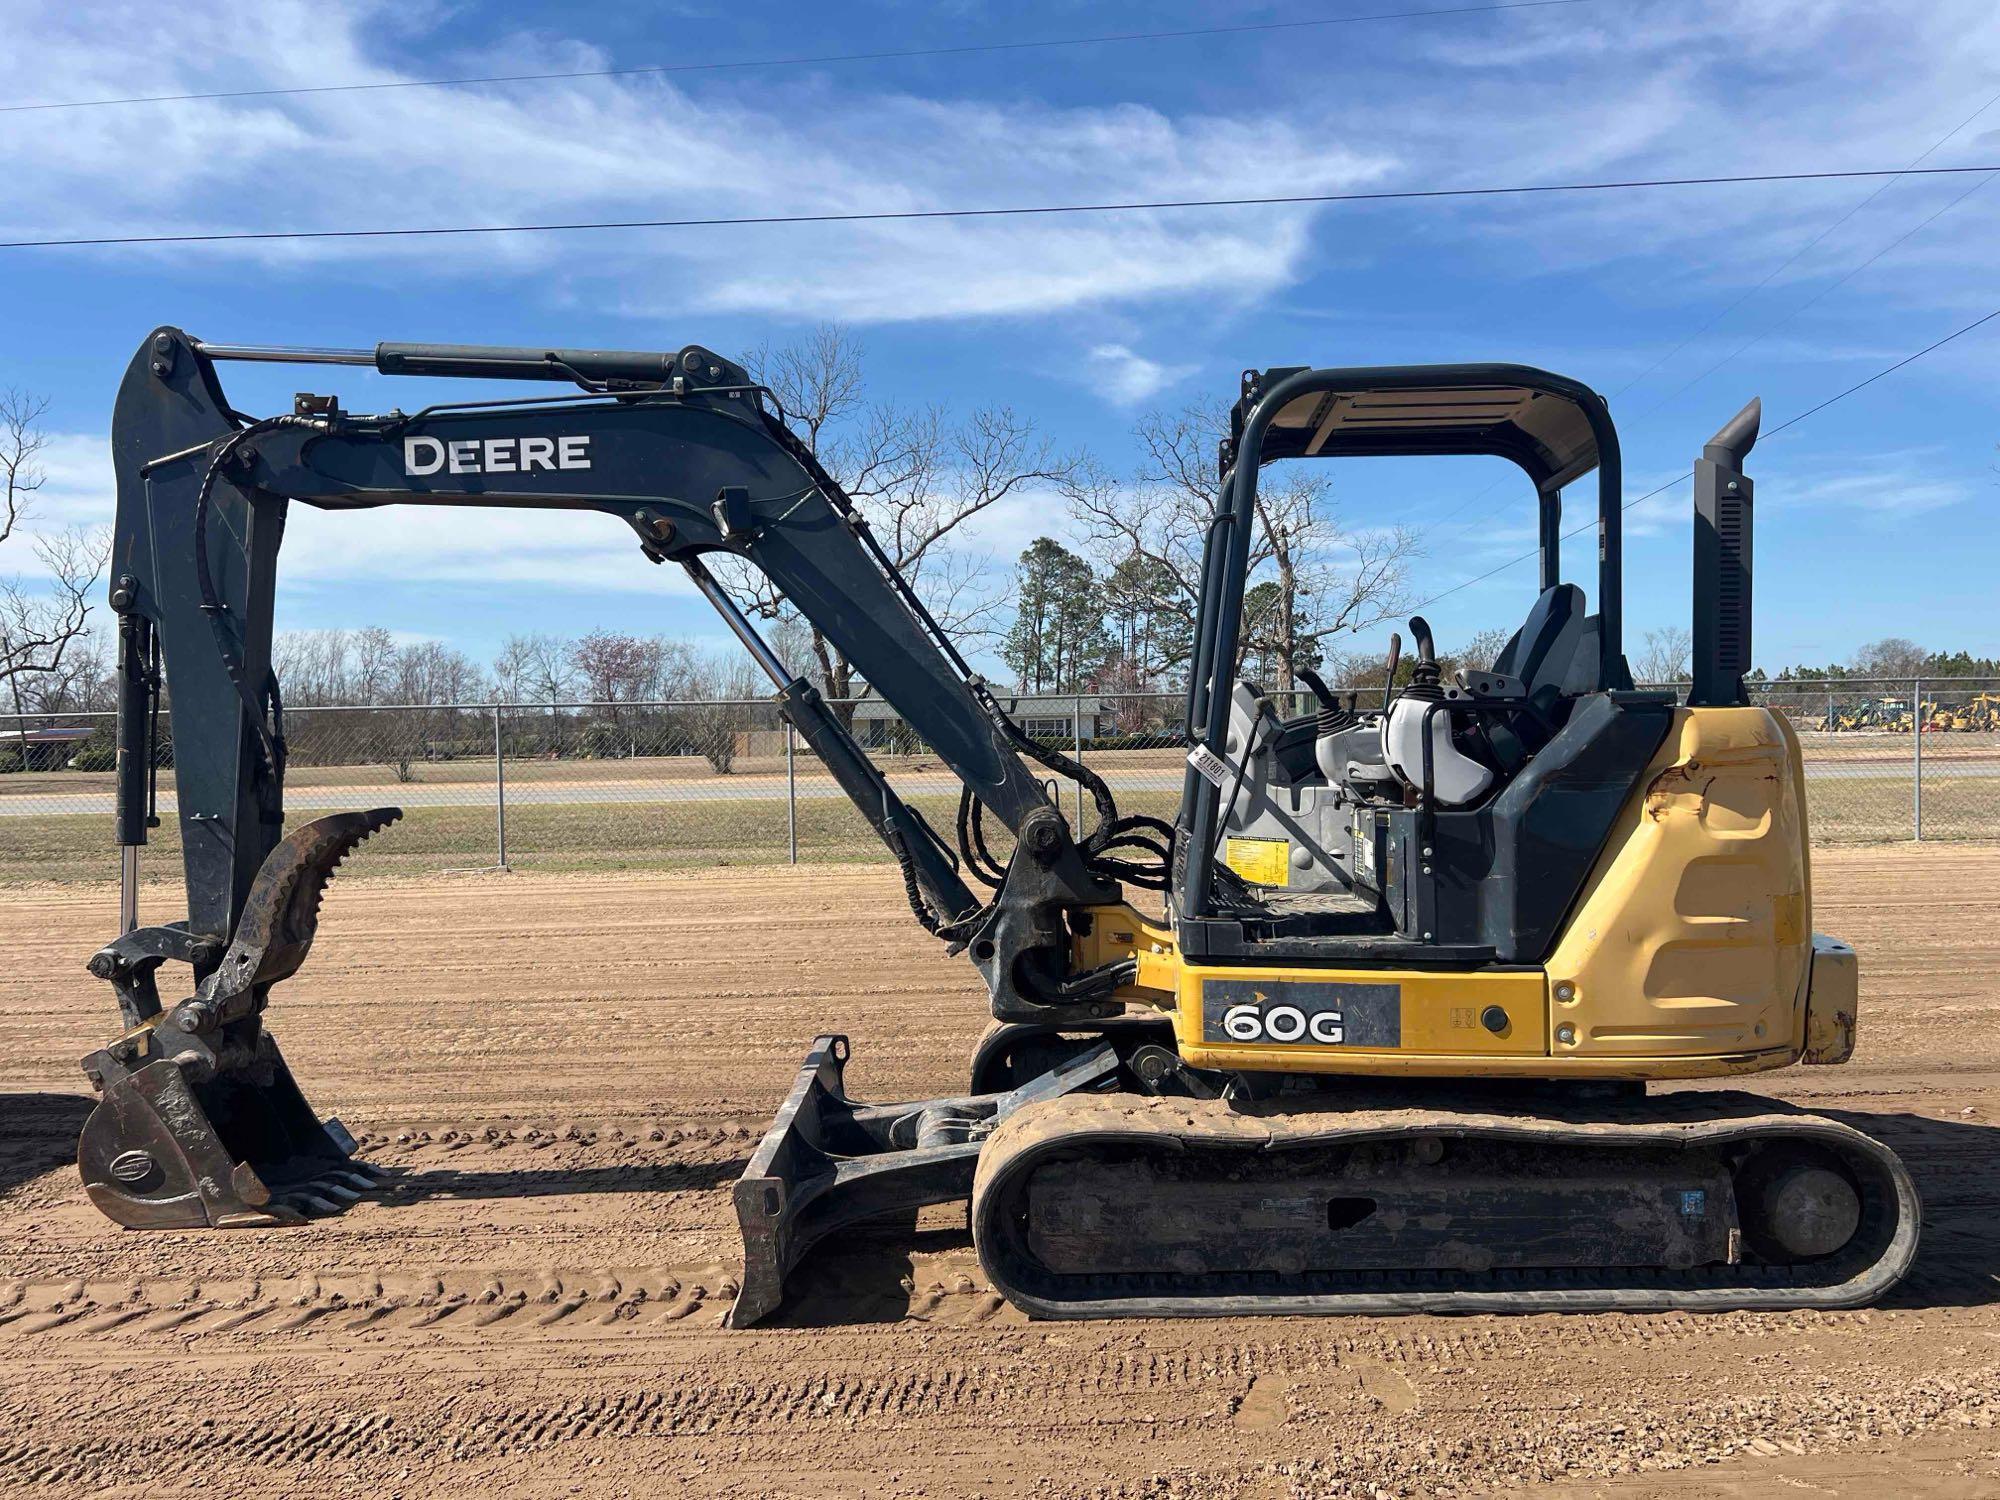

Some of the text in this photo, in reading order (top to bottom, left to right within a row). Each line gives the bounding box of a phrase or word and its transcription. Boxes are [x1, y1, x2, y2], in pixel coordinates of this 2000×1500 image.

[404, 435, 591, 476] DEERE
[1198, 753, 1226, 778] 211801
[1223, 1004, 1344, 1043] 60G
